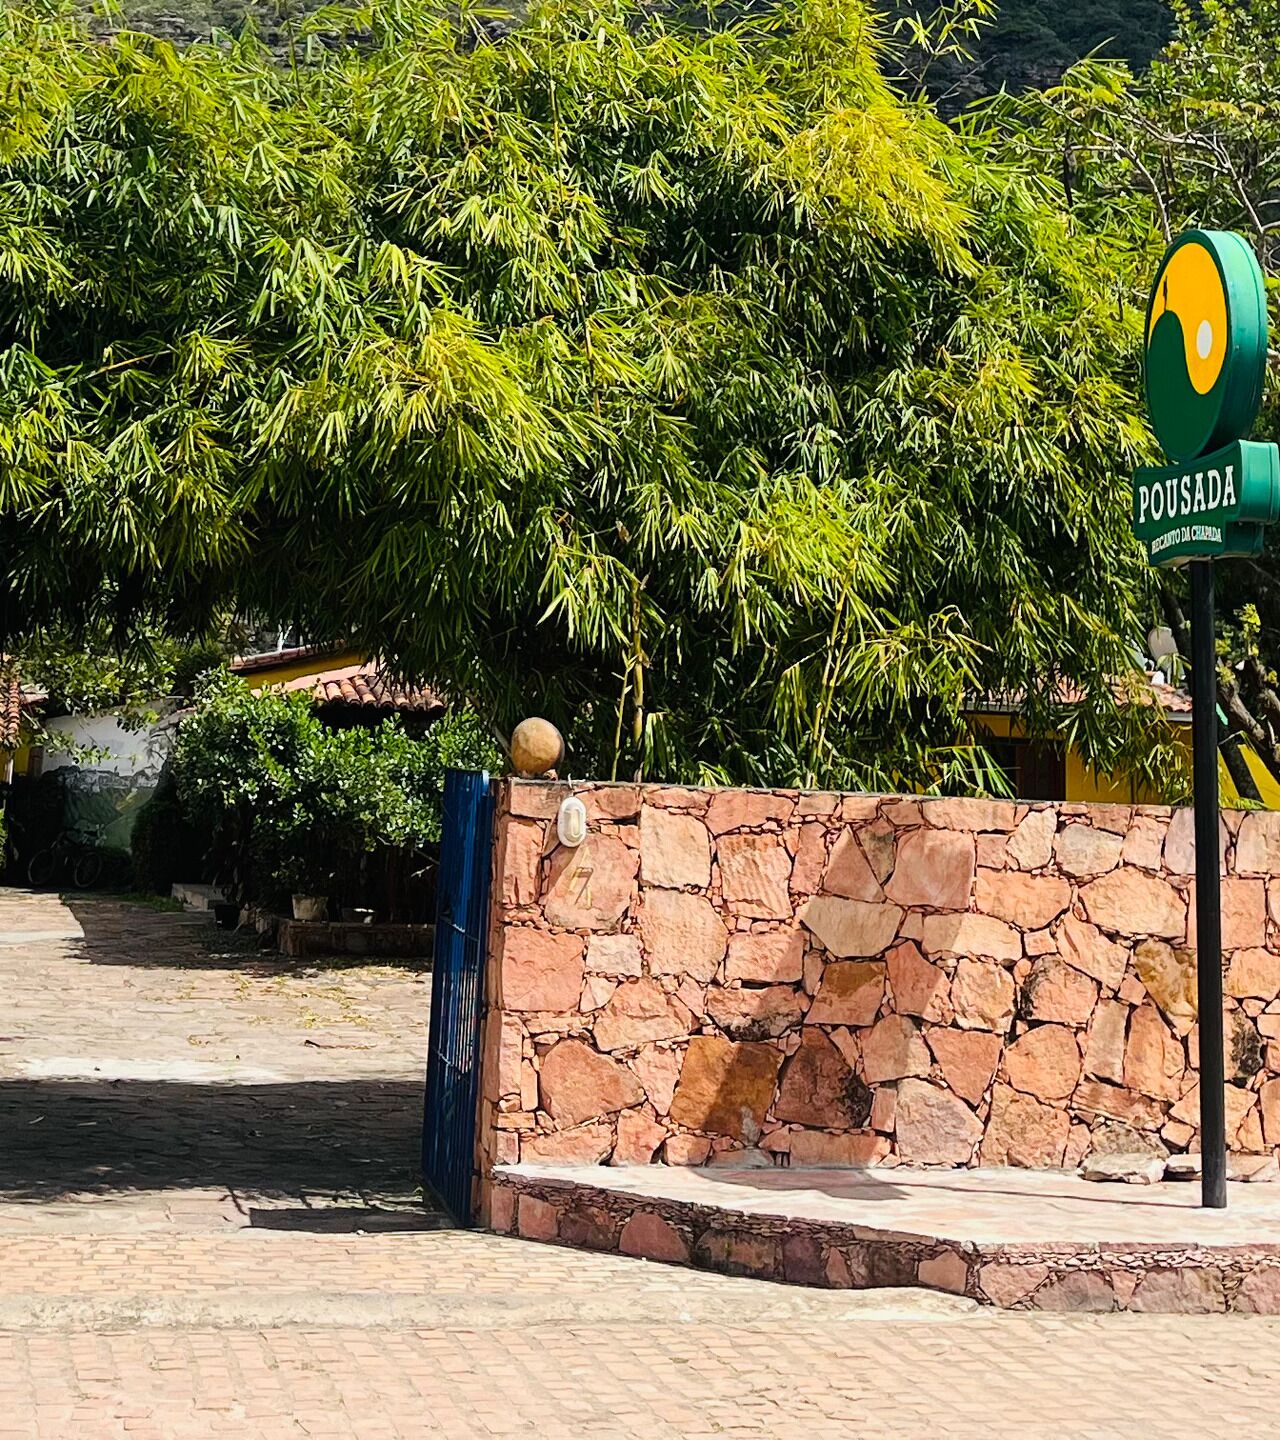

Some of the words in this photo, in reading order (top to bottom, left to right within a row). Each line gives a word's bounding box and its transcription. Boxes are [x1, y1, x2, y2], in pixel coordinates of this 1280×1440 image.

[1138, 465, 1236, 524] POUSADA
[1181, 526, 1192, 543] DA
[1191, 525, 1223, 543] CHAPADA
